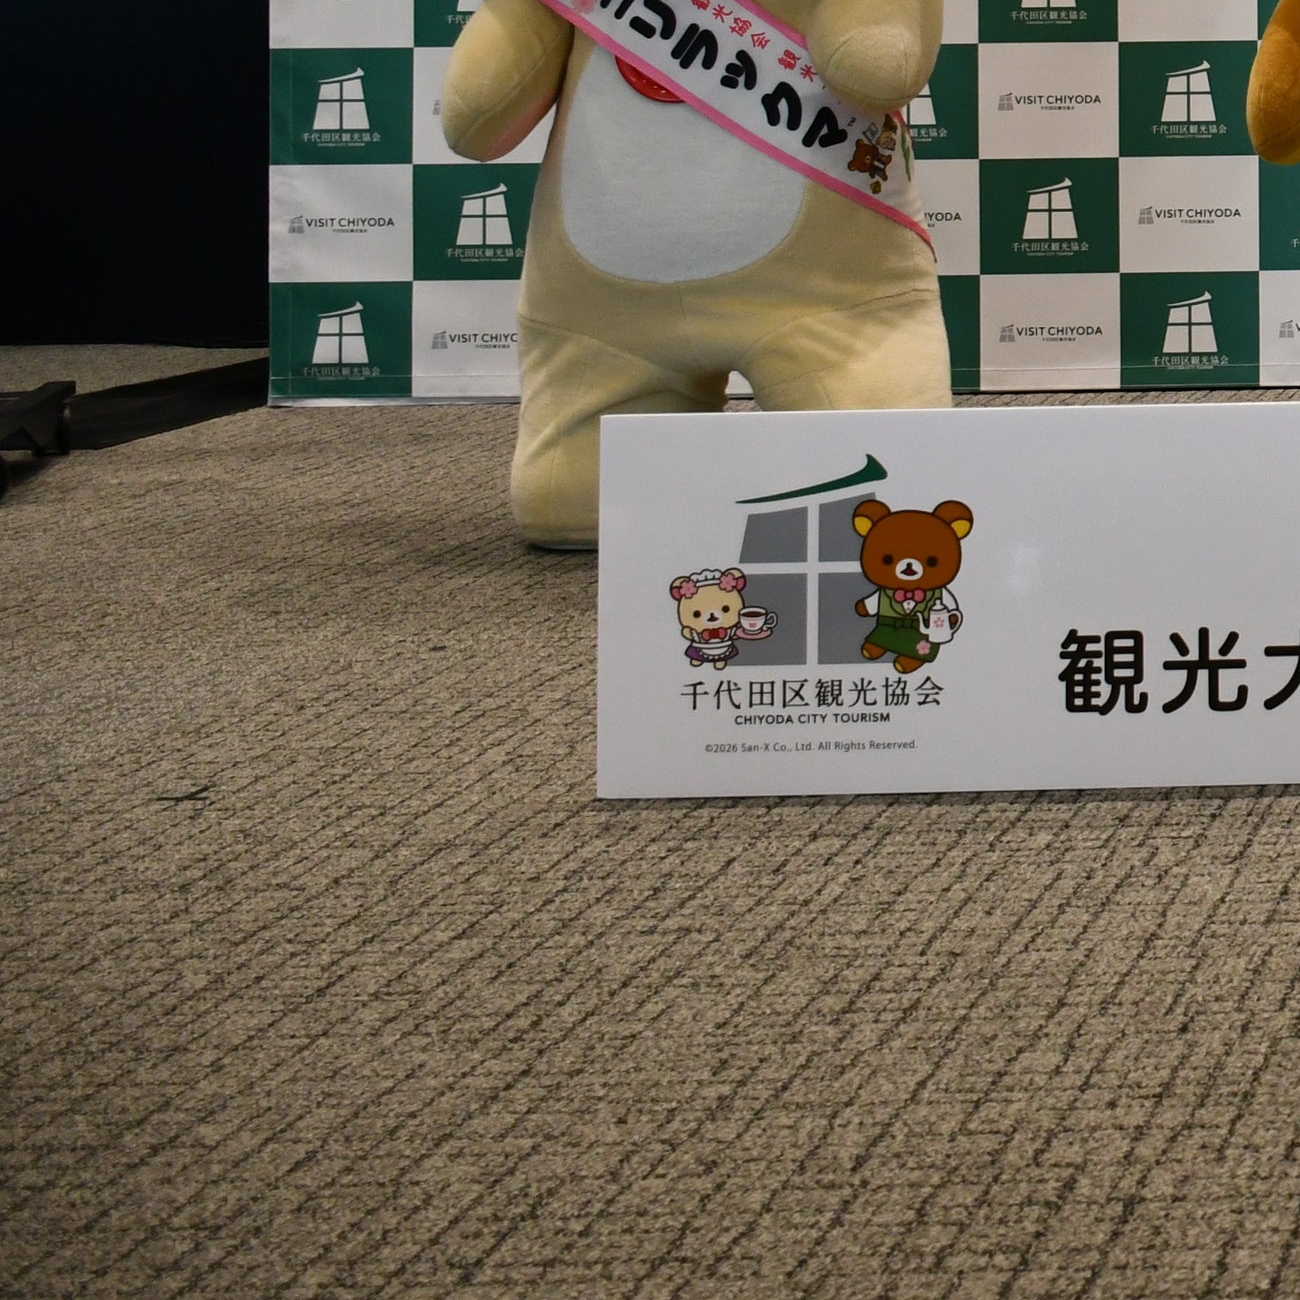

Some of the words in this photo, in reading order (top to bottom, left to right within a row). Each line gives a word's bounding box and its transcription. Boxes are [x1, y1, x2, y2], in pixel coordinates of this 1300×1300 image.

[1014, 94, 1044, 105] VISIT
[1046, 94, 1101, 104] CHIYODA
[1154, 209, 1184, 219] VISIT
[1186, 208, 1241, 219] CHIYODA
[306, 218, 336, 228] VISIT
[338, 217, 395, 228] CHIYODA
[1016, 326, 1046, 336] VISIT
[1047, 325, 1103, 336] CHIYODA
[449, 333, 479, 343] VISIT
[680, 676, 945, 711] 千代田区観光協会
[734, 714, 794, 726] CHIYODA
[798, 714, 828, 725] CITY
[833, 712, 891, 724] TOURISM
[741, 742, 770, 752] San-X
[818, 741, 832, 751] All
[835, 740, 866, 753] Rights
[869, 739, 919, 751] Reserved.
